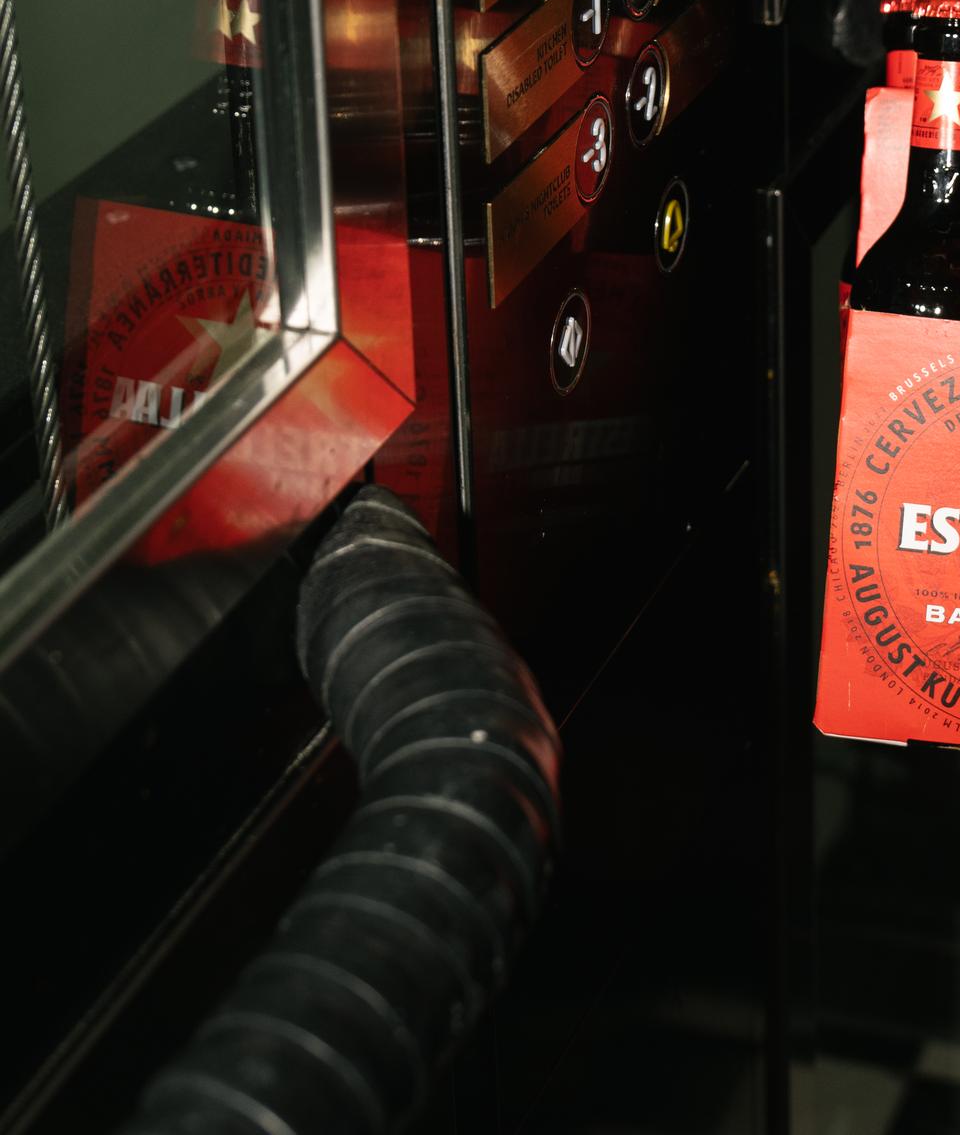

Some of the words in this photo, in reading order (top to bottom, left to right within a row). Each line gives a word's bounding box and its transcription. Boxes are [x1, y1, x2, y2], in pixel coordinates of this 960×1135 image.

[536, 24, 568, 65] KITCHEN
[506, 65, 543, 108] DISABLED
[544, 41, 568, 76] TOILET
[634, 67, 655, 121] -2
[582, 118, 606, 172] -3
[533, 164, 571, 211] NIGHTCLUB
[544, 181, 571, 219] TOILETS
[888, 353, 956, 402] BRUSSELS
[850, 488, 878, 550] 1876
[915, 588, 950, 603] 100%
[841, 610, 863, 642] 2018
[850, 563, 927, 678] AUGUST
[859, 645, 904, 697] LONDON
[908, 696, 939, 719] 2014
